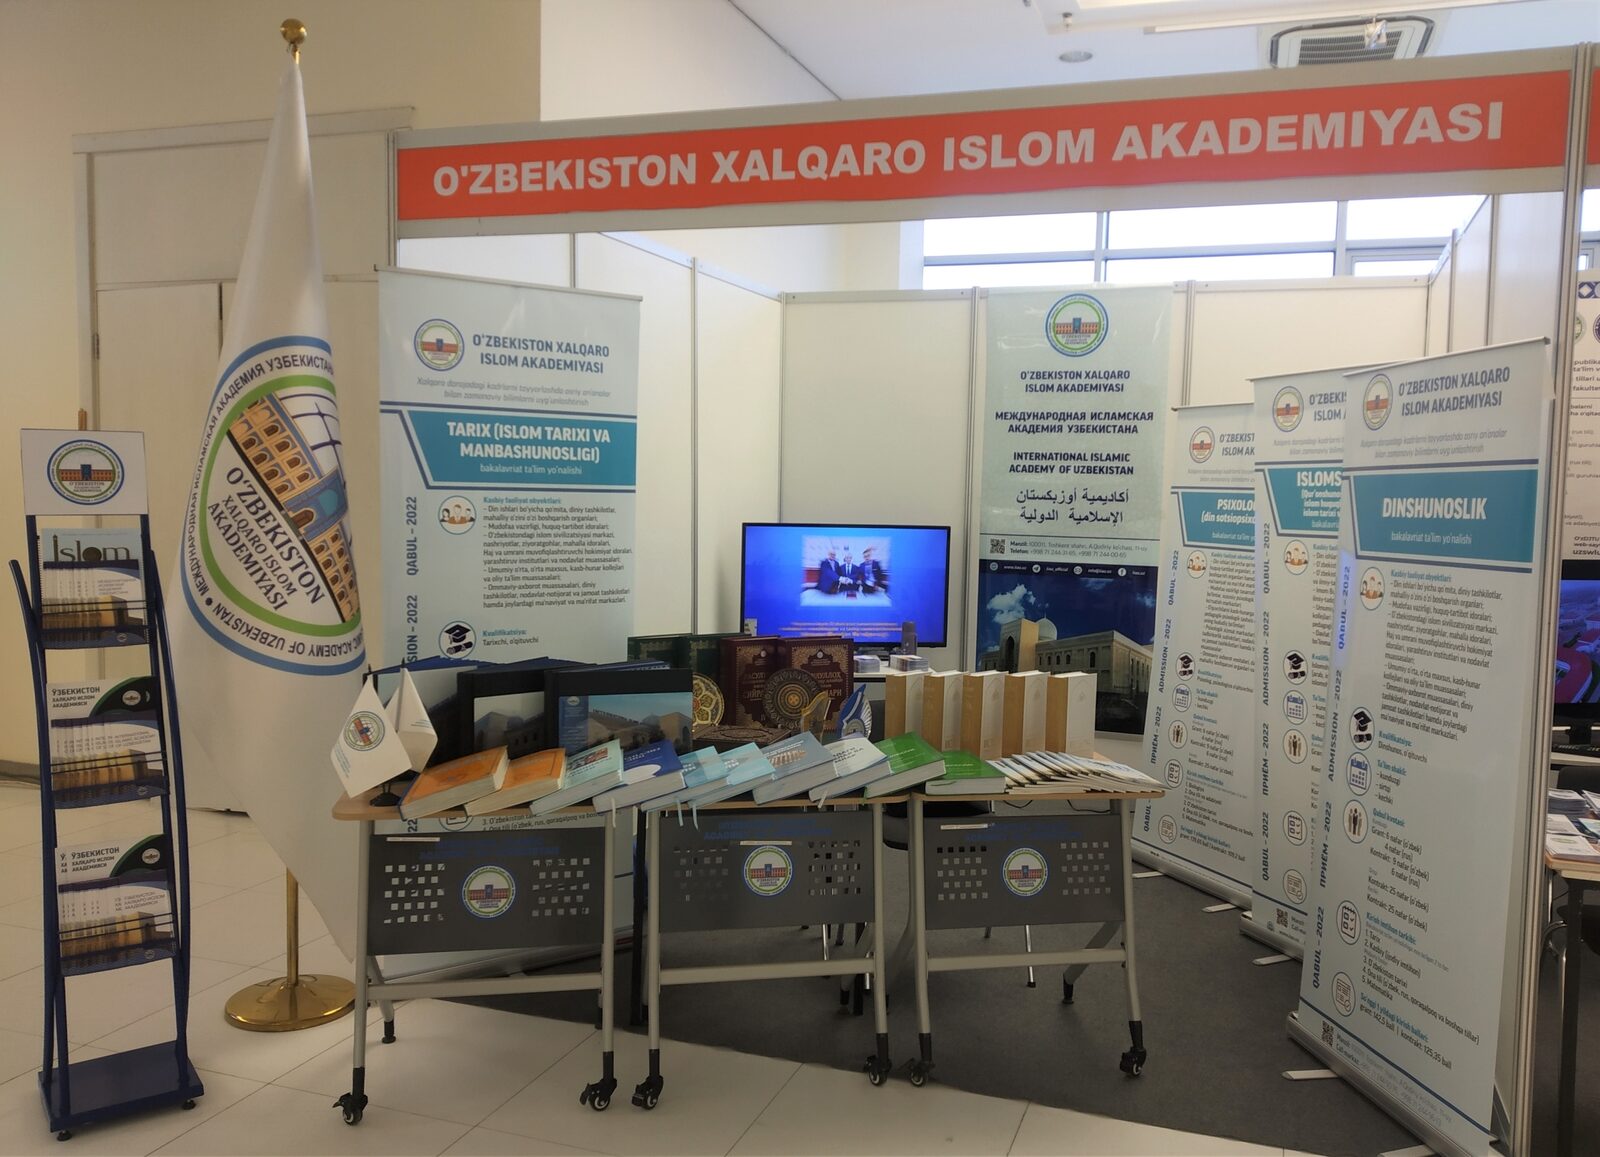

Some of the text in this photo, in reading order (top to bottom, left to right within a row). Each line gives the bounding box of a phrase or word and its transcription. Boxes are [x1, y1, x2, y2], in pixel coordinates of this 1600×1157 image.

[433, 101, 1504, 196] O'ZBEKISTON XALQARO ISLOM AKADEMIYASI
[472, 334, 610, 358] O'ZBEKISTON XALQARO
[480, 352, 604, 374] ISLOM AKADEMIYASI
[1020, 370, 1130, 380] O'ZBEKISTON XALQARO
[1398, 366, 1510, 397] O'ZBEKISTON XALQARO
[1025, 383, 1124, 393] ISLOM AKADEMIYASI
[1402, 391, 1503, 417] ISLOM AKADEMIYASI
[995, 411, 1154, 422] МЕЖДУНАРОДНАЯ ИСЛАМСКАЯ
[1314, 409, 1342, 422] ISLOM
[447, 421, 610, 443] TARIX (ISLOM TARIXI VA
[1008, 424, 1138, 434] АКАДЕМИЯ УЗБЕКИСТАНА
[460, 443, 600, 463] MANBASHUNOSLIGI)
[1013, 452, 1131, 462] INTERNATIONAL ISLAMIC
[1222, 446, 1244, 456] ISLOM
[187, 353, 334, 596] МЕЖДУНАРОДНАЯ ИСЛАМСКАЯ АКАДЕМИЯ УЗБЕКИСТАН
[480, 463, 523, 474] bakalavriat
[1009, 464, 1134, 475] ACADEMY OF UZBEKISTAN
[1296, 471, 1342, 487] ISLOMS
[1016, 487, 1129, 506] أكاديمية أوزبكستان
[1217, 498, 1255, 511] PSIXOLO
[406, 496, 418, 526] 2022
[1019, 507, 1123, 527] الإسلامية الدولية
[1201, 510, 1215, 523] (din
[1382, 497, 1488, 520] DINSHUNOSLIK
[222, 494, 299, 597] XALQARO ISLOM
[226, 466, 326, 605] O‘ZBEKISTON
[1391, 532, 1424, 542] bakalavriat
[207, 501, 288, 611] AKADEMIYASI
[406, 536, 419, 576] QABUL
[1263, 559, 1271, 594] QABUL
[1168, 578, 1176, 606] QABUL
[407, 595, 418, 624] 2022
[212, 602, 286, 651] UZBEKISTAN
[1338, 609, 1347, 650] QABUL
[288, 640, 306, 654] OF
[309, 641, 353, 658] ACADEMY
[1158, 646, 1168, 693] ADMISSION
[52, 686, 100, 697] ЎЗБЕКИСТОН
[1328, 711, 1339, 782] ADMISSION
[1324, 801, 1332, 833] 2022
[1372, 825, 1386, 837] Grant:
[71, 847, 120, 860] ЎЗБЕКИСТОН
[1370, 847, 1392, 863] Kontrakt:
[1368, 876, 1389, 892] Kontrakt:
[1366, 893, 1388, 911] Kontrakt:
[1312, 906, 1325, 989] QABUL 2022
[1366, 978, 1393, 1001] Matematika
[1438, 1014, 1445, 1023] va
[1445, 1017, 1464, 1035] boshqa
[1385, 1019, 1395, 1032] ball
[1401, 1028, 1423, 1051] kontrakt:
[1441, 1053, 1452, 1070] ball
